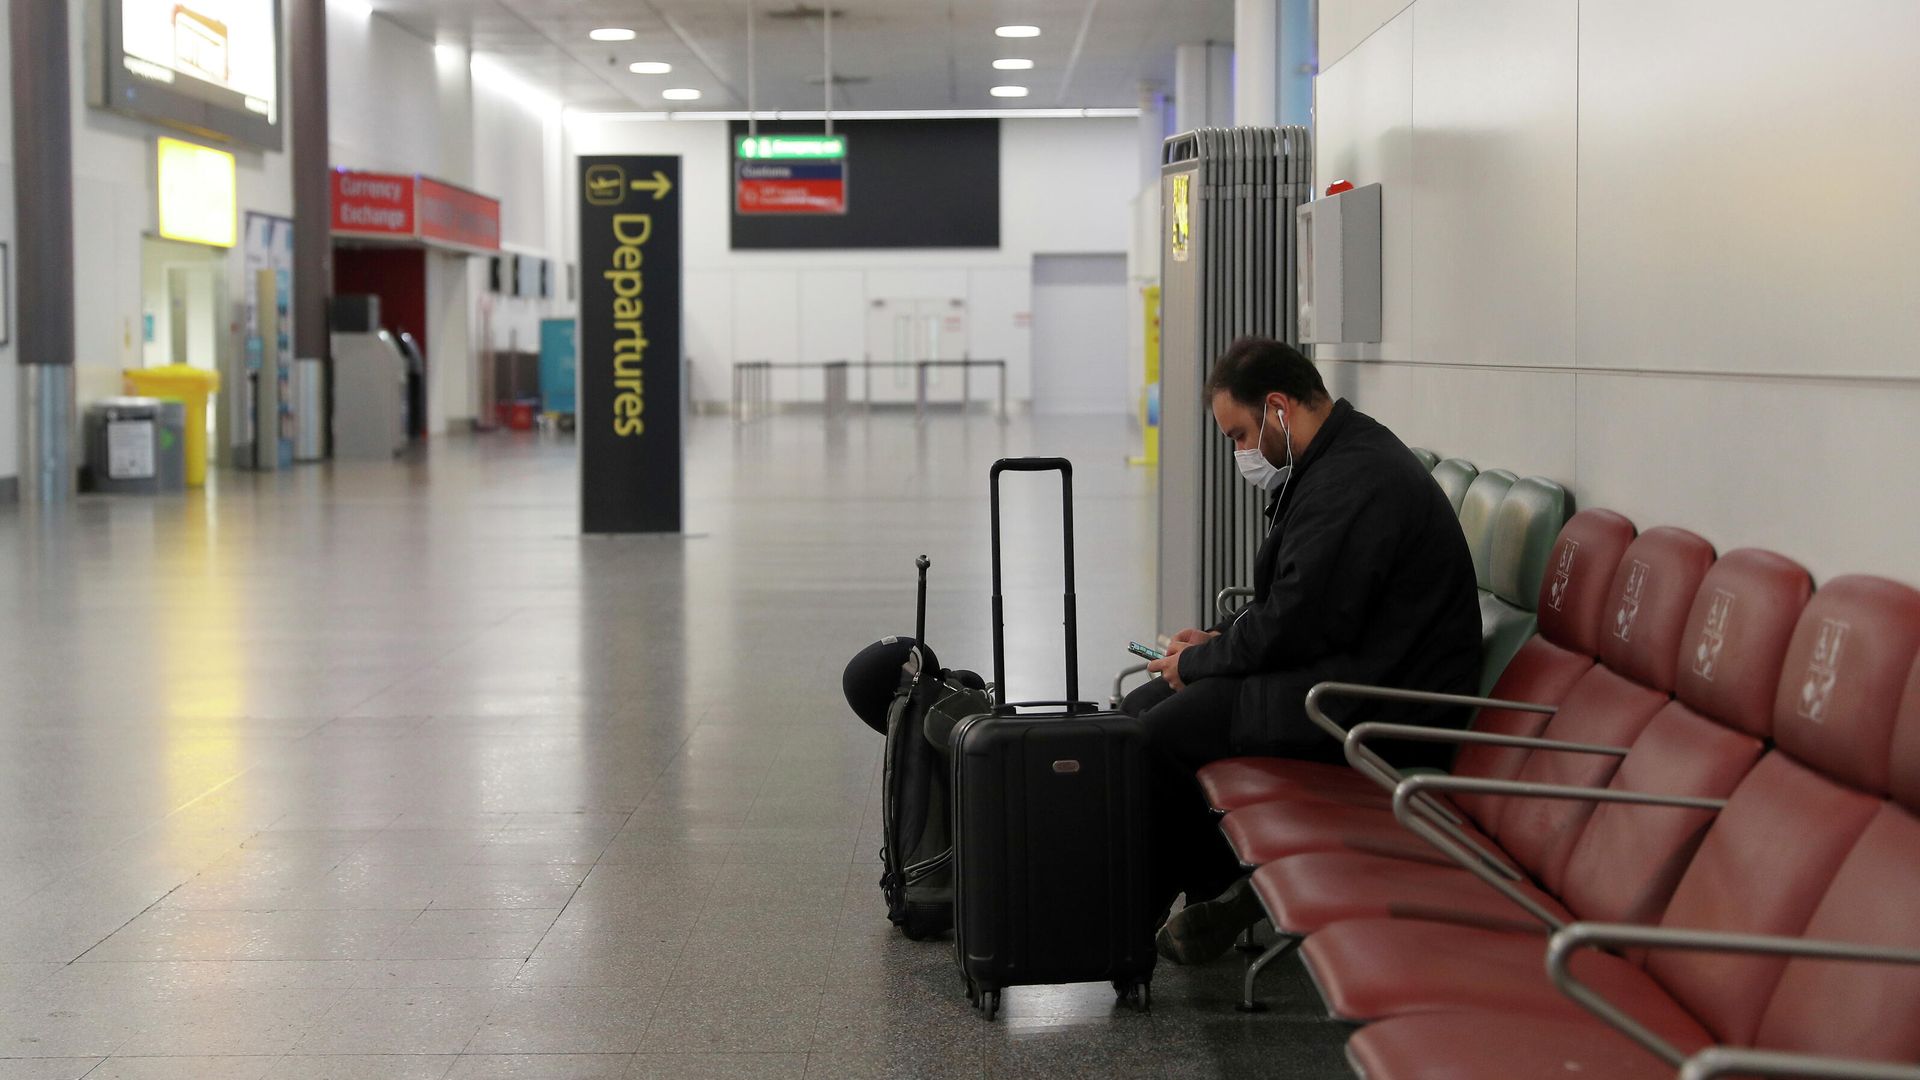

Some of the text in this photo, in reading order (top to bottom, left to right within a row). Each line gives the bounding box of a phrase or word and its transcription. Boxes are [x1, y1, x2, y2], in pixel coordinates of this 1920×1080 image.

[340, 176, 402, 202] Currency
[340, 202, 406, 228] Exchange
[603, 213, 652, 437] Departures
